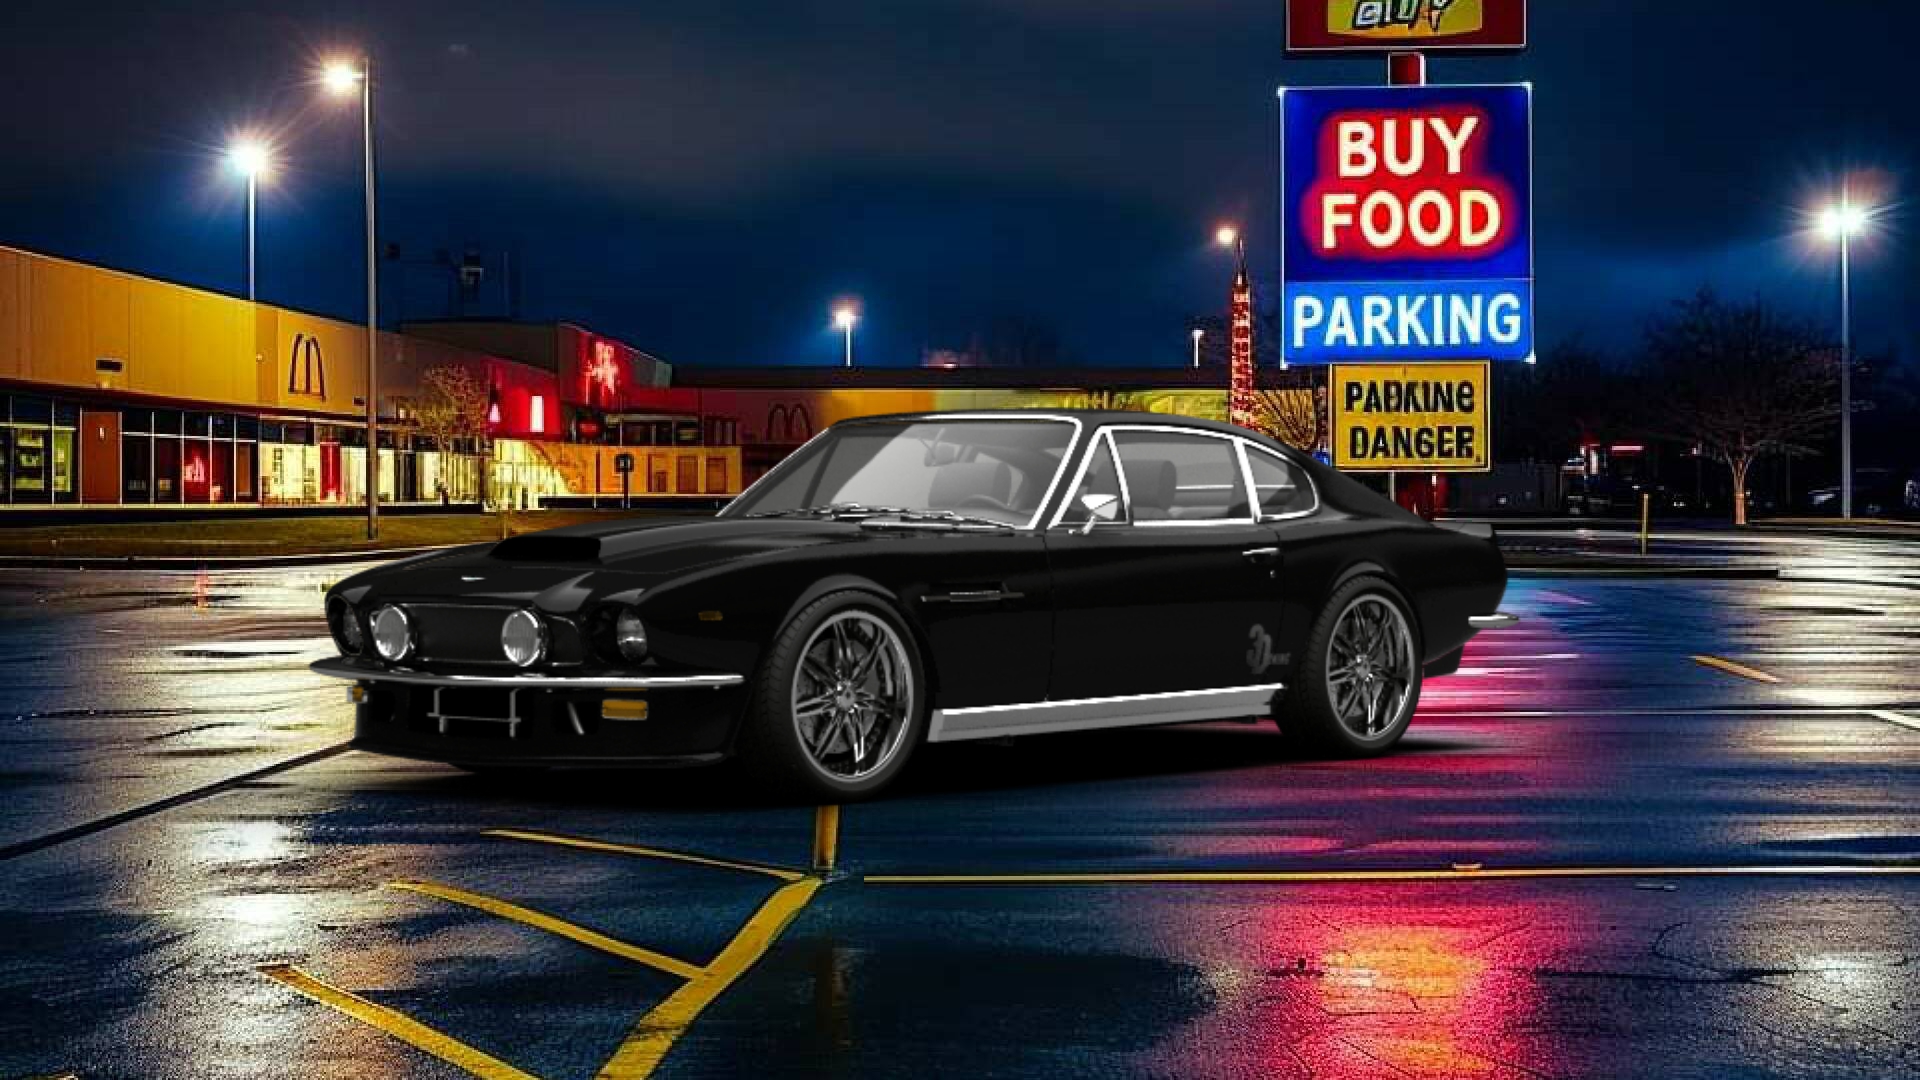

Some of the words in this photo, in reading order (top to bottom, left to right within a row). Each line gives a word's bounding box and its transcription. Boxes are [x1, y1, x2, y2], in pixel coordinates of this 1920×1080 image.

[1338, 116, 1479, 177] BUY
[1322, 189, 1501, 248] FOOD
[1293, 293, 1521, 348] PARKING
